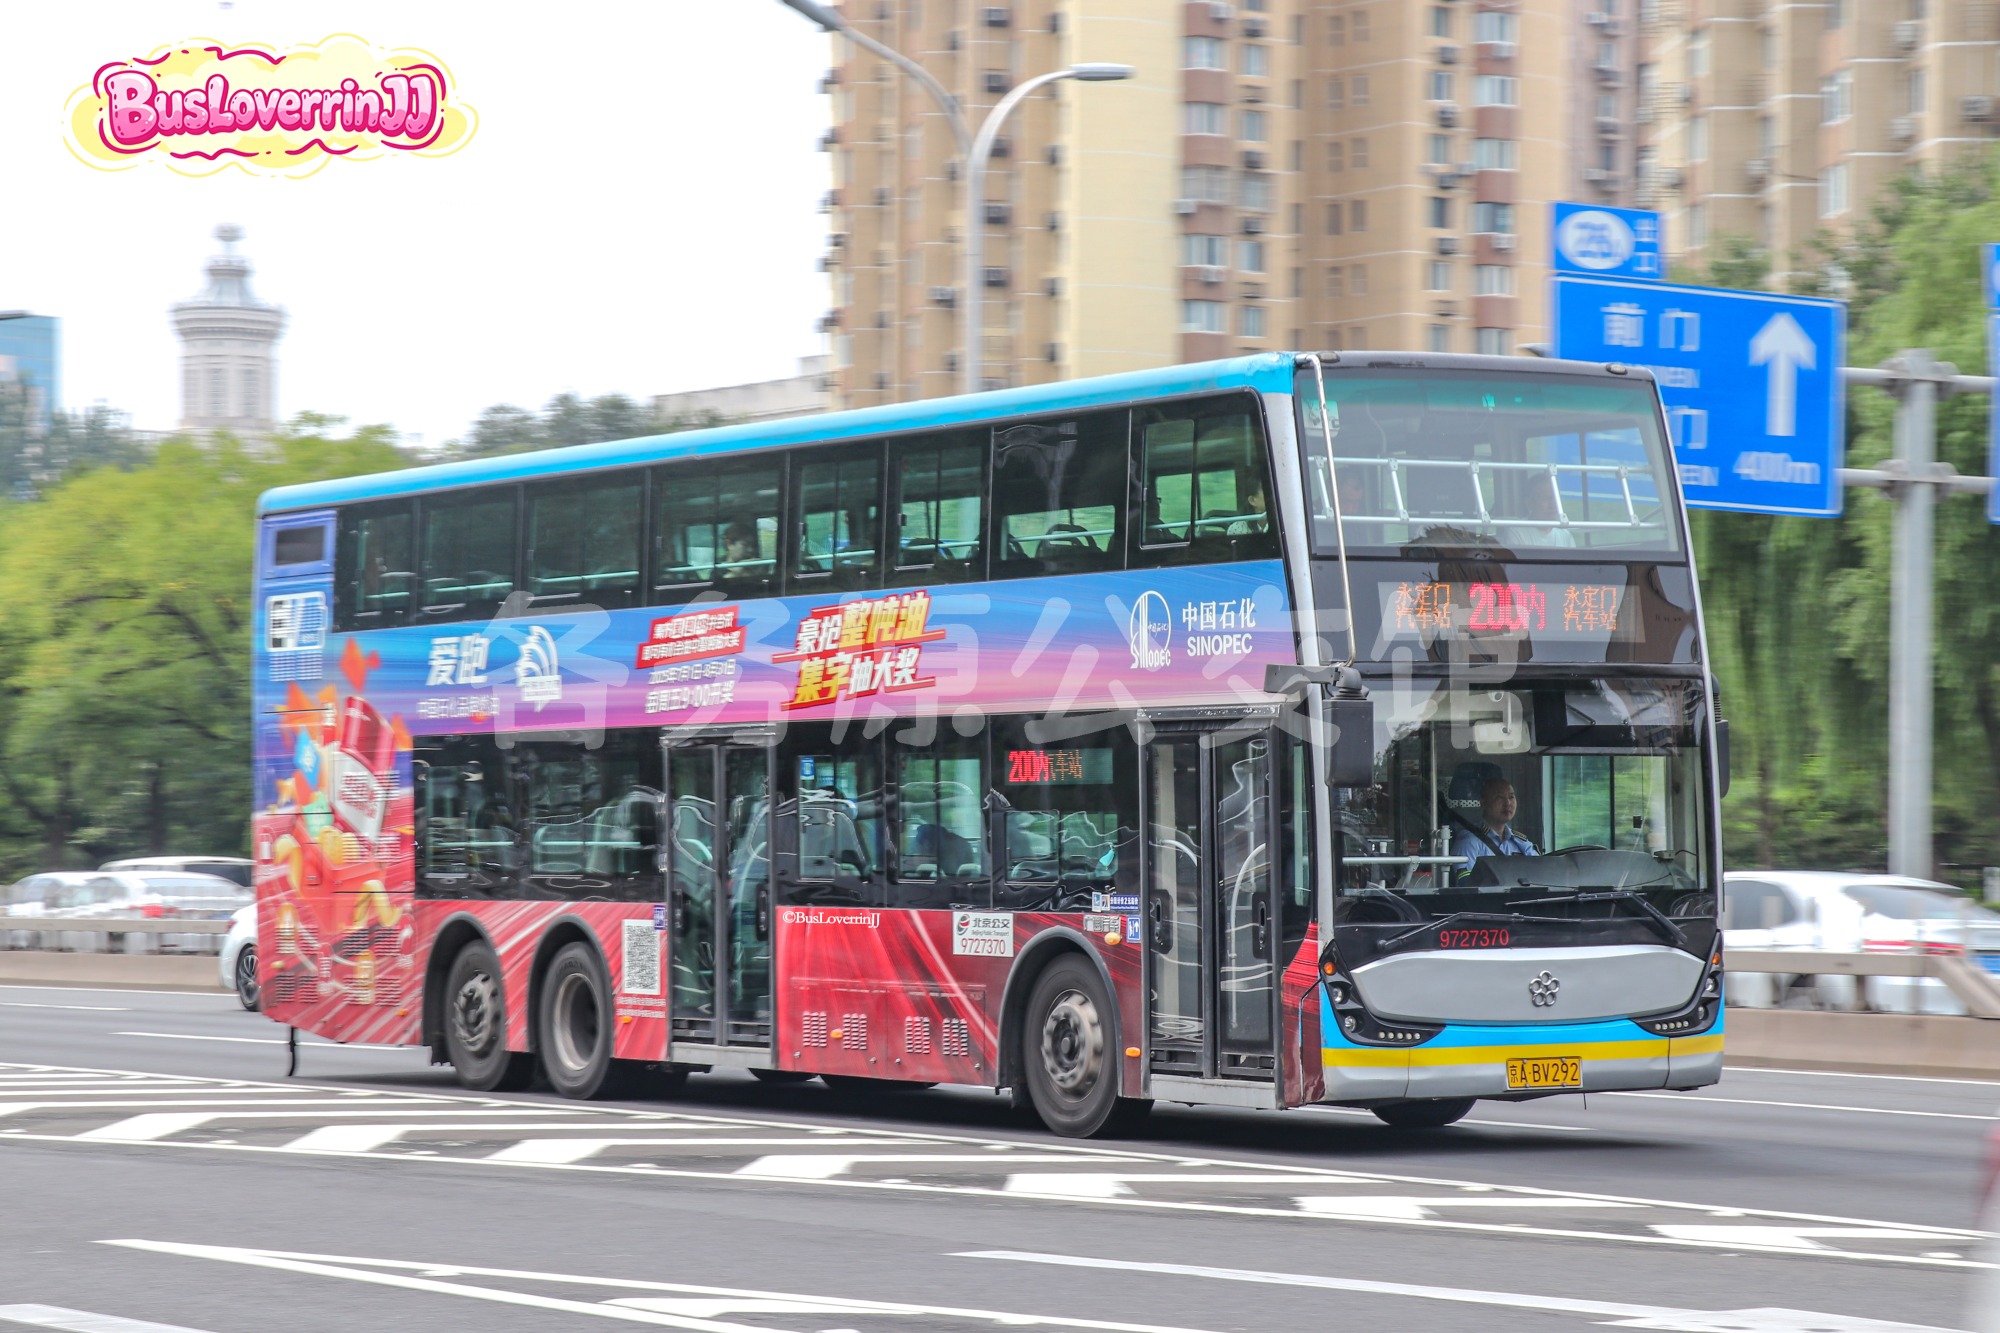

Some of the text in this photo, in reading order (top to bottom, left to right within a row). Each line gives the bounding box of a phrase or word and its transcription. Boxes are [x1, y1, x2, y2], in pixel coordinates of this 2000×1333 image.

[1396, 583, 1450, 606] 永定门
[1563, 586, 1617, 609] 永定门
[1182, 598, 1256, 632] 中国石化
[1395, 606, 1450, 629] 汽车站
[1563, 608, 1617, 631] 汽车站
[1187, 633, 1253, 657] SINOPEC
[972, 918, 1010, 929] 北京公交
[961, 938, 1006, 955] 9727370
[1440, 928, 1510, 949] 9727370
